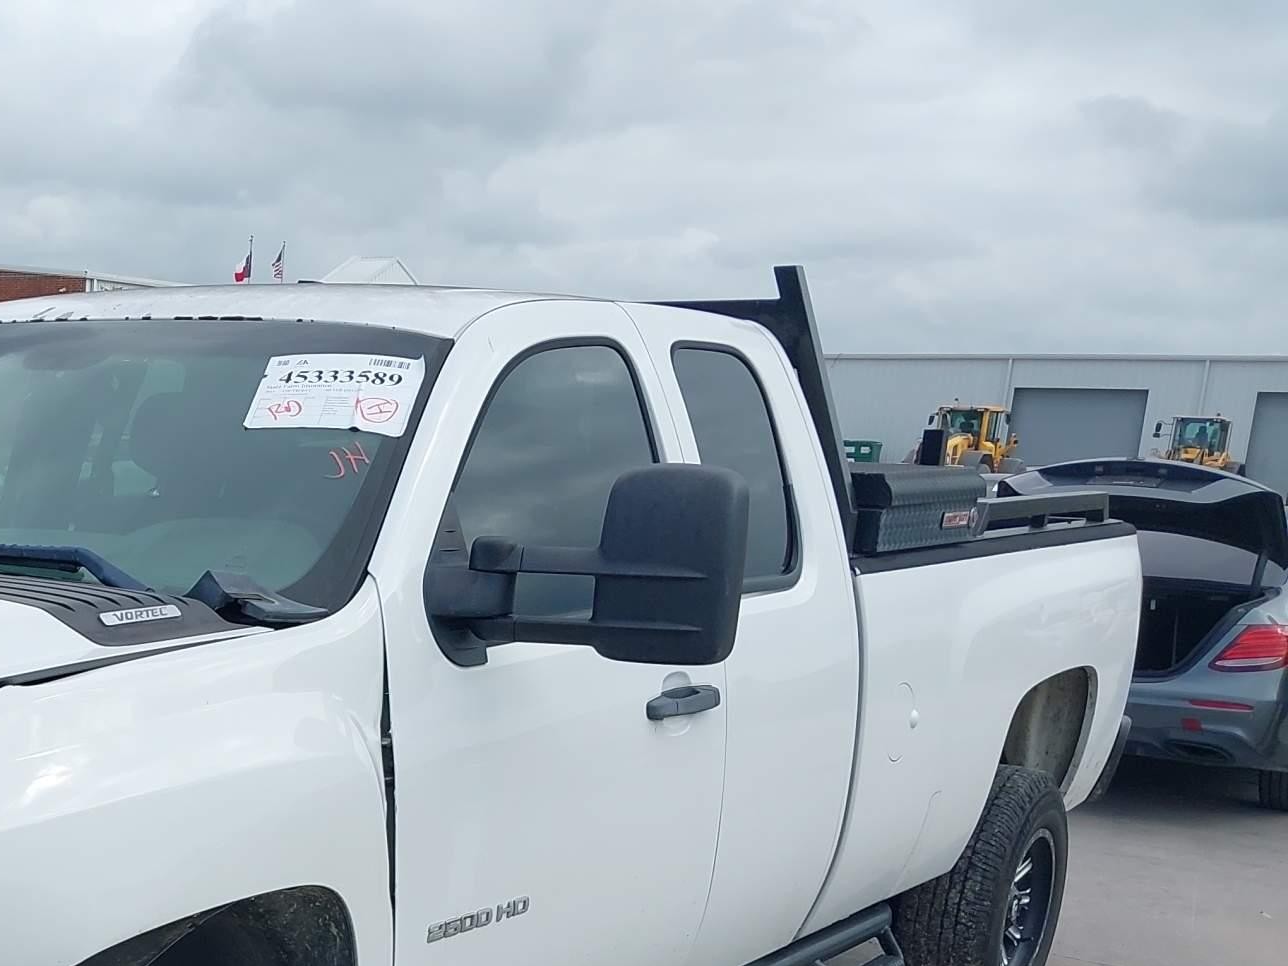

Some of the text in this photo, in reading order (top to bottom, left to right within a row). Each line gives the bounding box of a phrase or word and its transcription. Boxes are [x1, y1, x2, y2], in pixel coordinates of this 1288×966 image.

[278, 369, 404, 387] 45333589
[113, 606, 168, 622] VORTEC
[426, 896, 530, 944] 2500 HD
